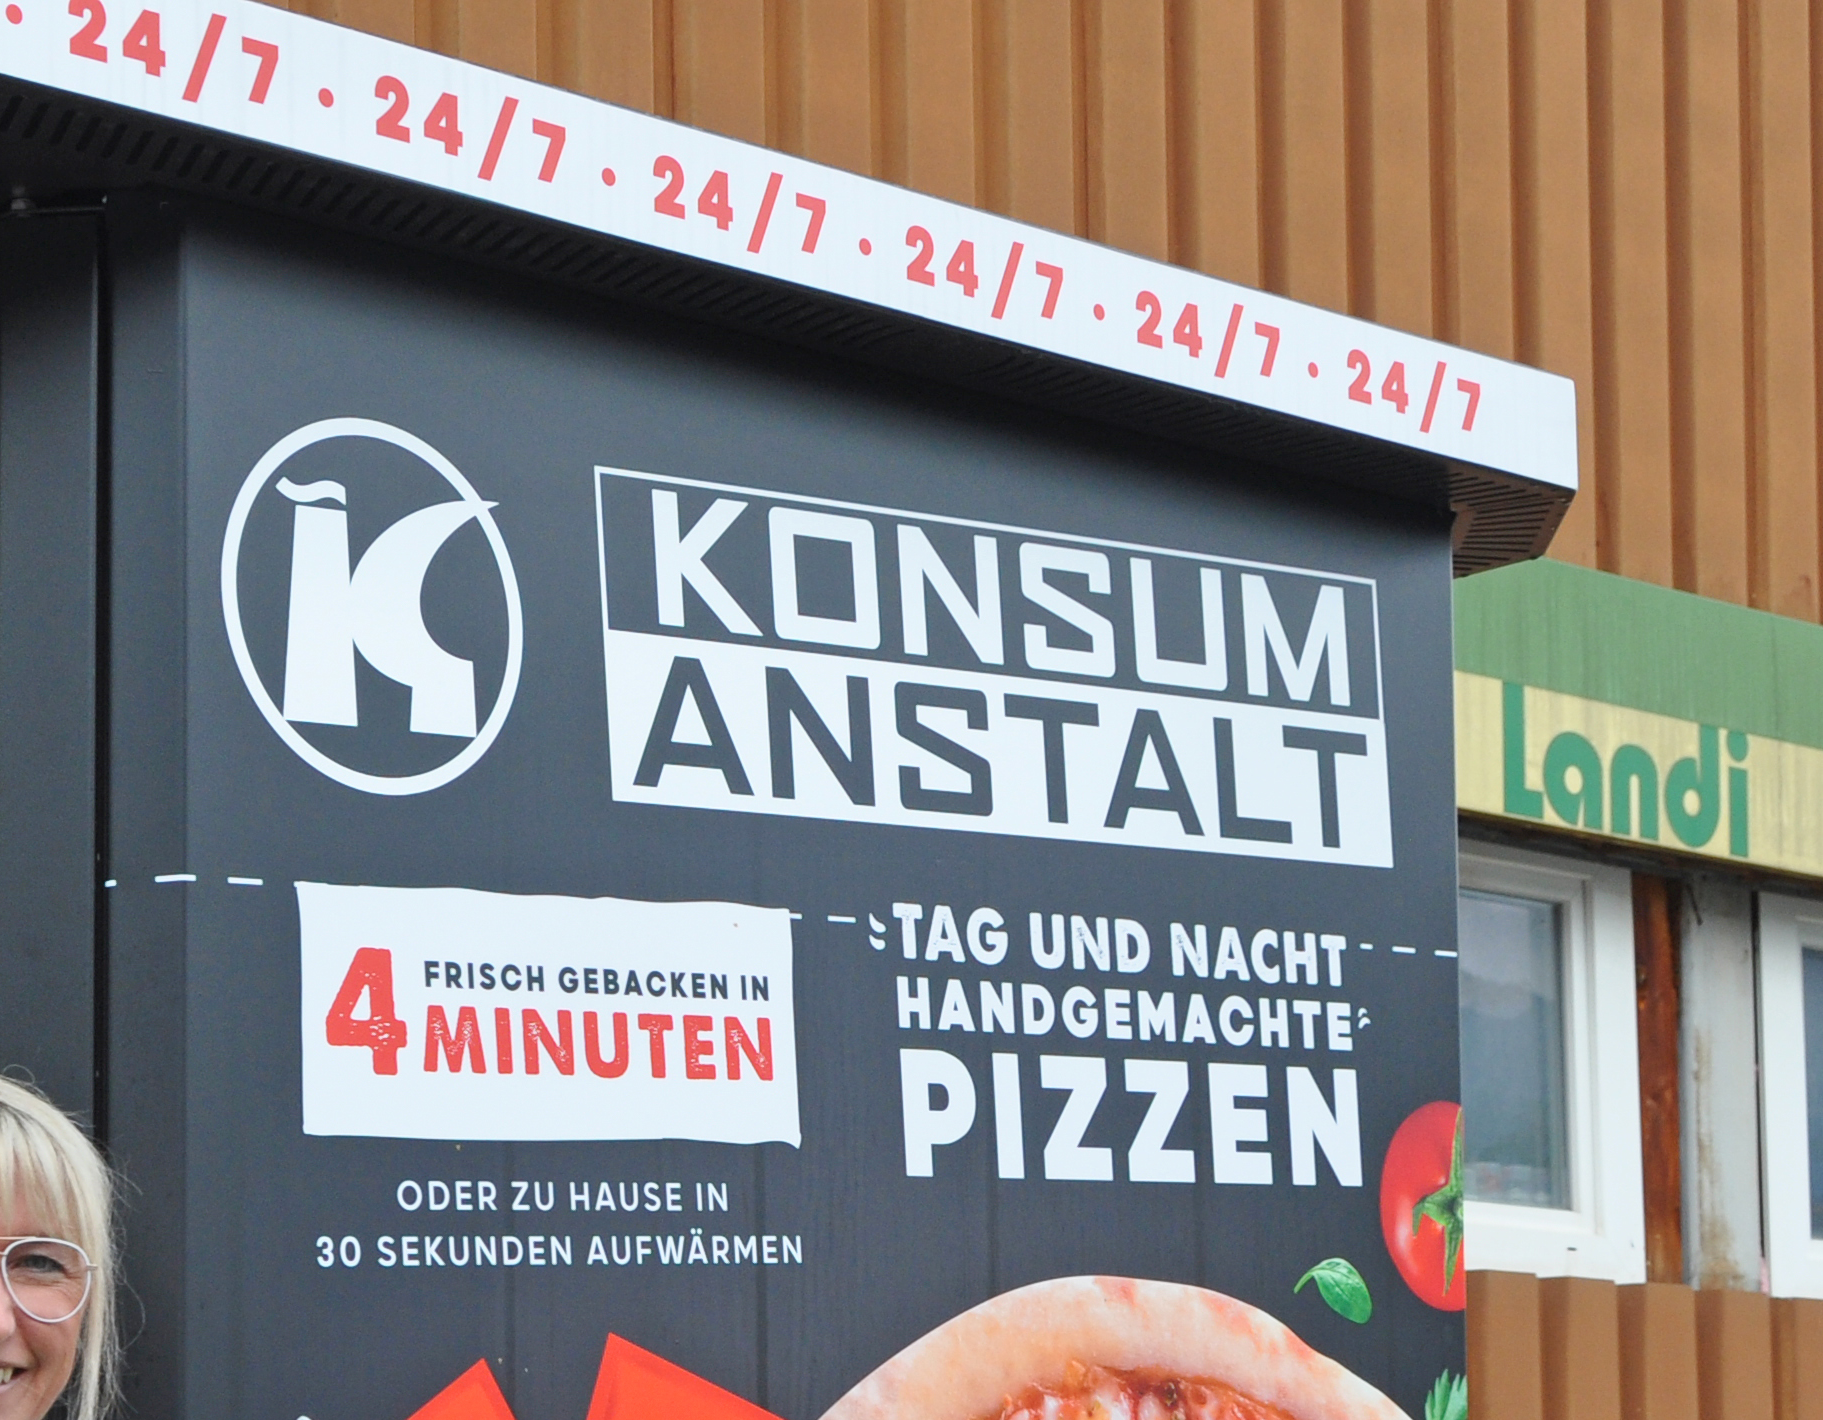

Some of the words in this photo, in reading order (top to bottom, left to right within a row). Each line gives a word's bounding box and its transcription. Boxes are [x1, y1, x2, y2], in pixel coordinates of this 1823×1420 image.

[67, 0, 280, 104] 24/7
[375, 75, 567, 183] 24/7
[652, 155, 827, 254] 24/7
[905, 225, 1064, 320] 24/7
[1135, 291, 1280, 379] 24/7
[1346, 348, 1481, 434] 24/7
[651, 488, 1351, 707] KONSUM
[632, 655, 1368, 849] ANSTALT
[1501, 680, 1749, 859] Landi
[423, 960, 544, 993] FRISCH
[557, 966, 729, 1001] GEBACKEN
[740, 975, 770, 1002] IN
[892, 902, 1009, 966] TAG
[1029, 911, 1151, 974] UND
[1170, 921, 1347, 987] NACHT
[325, 946, 408, 1076] 4
[423, 1004, 774, 1082] MINUTEN
[896, 975, 1354, 1052] HANDGEMACHTE
[899, 1047, 1363, 1188] PIZZEN
[316, 1235, 362, 1268] 30
[377, 1235, 573, 1267] SEKUNDEN
[587, 1228, 804, 1266] AUFWÄRMEN
[396, 1180, 498, 1213] ODER
[511, 1181, 555, 1213] ZU
[569, 1181, 683, 1213] HAUSE
[696, 1182, 729, 1213] IN
